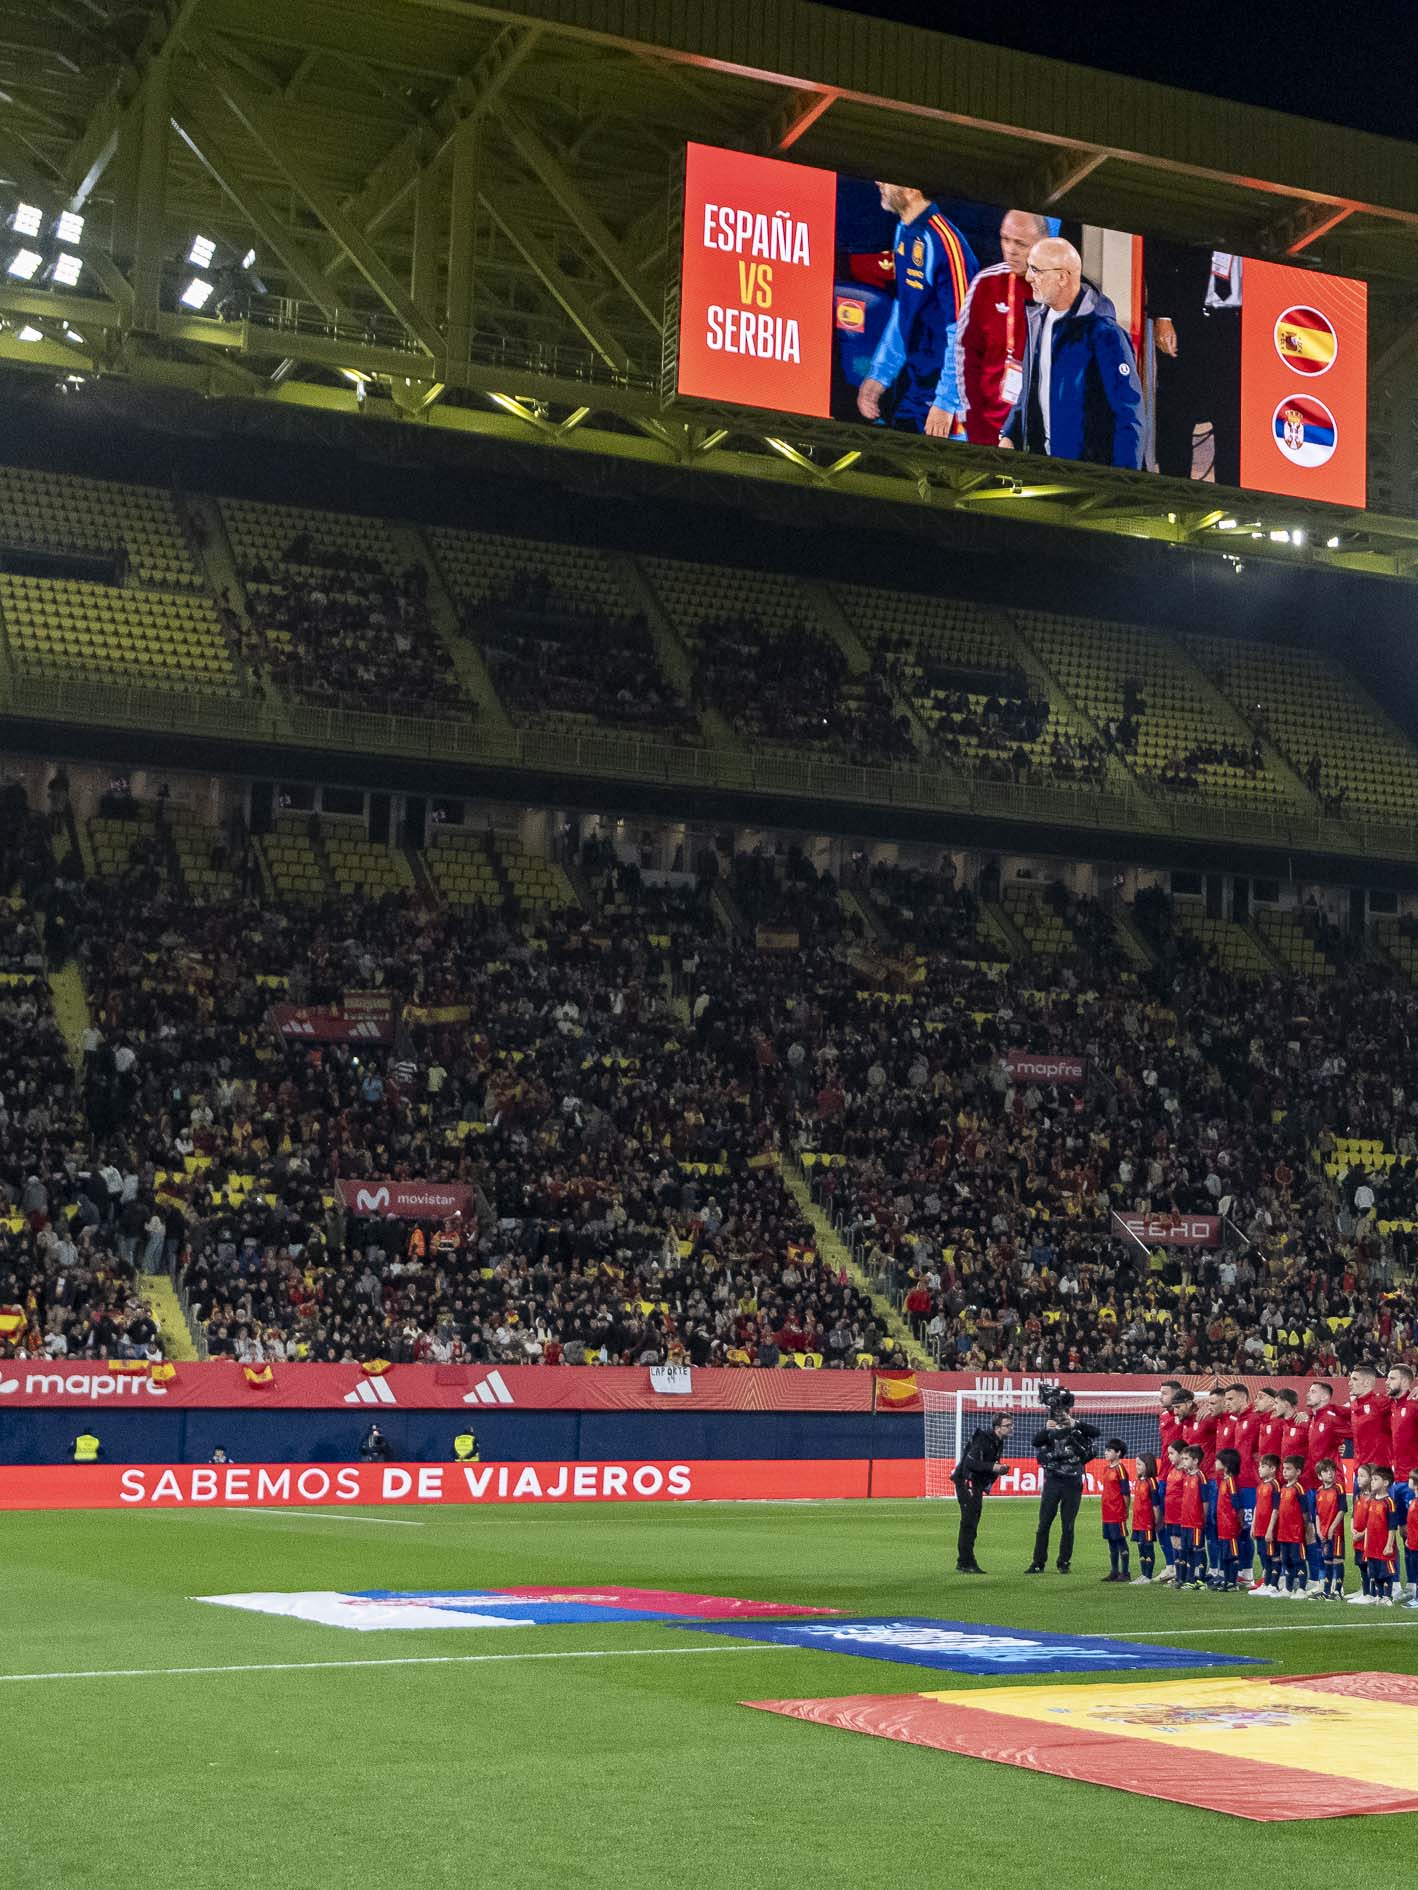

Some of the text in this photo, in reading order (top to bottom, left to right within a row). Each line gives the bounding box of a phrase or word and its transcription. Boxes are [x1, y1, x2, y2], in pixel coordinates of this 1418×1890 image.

[703, 203, 810, 267] ESPAÑA
[738, 259, 773, 309] VS
[706, 304, 801, 364] SERBIA
[1017, 1062, 1083, 1077] mapfre
[397, 1192, 456, 1205] movistar
[119, 1465, 693, 1501] SABEMOS DE VIAJEROS
